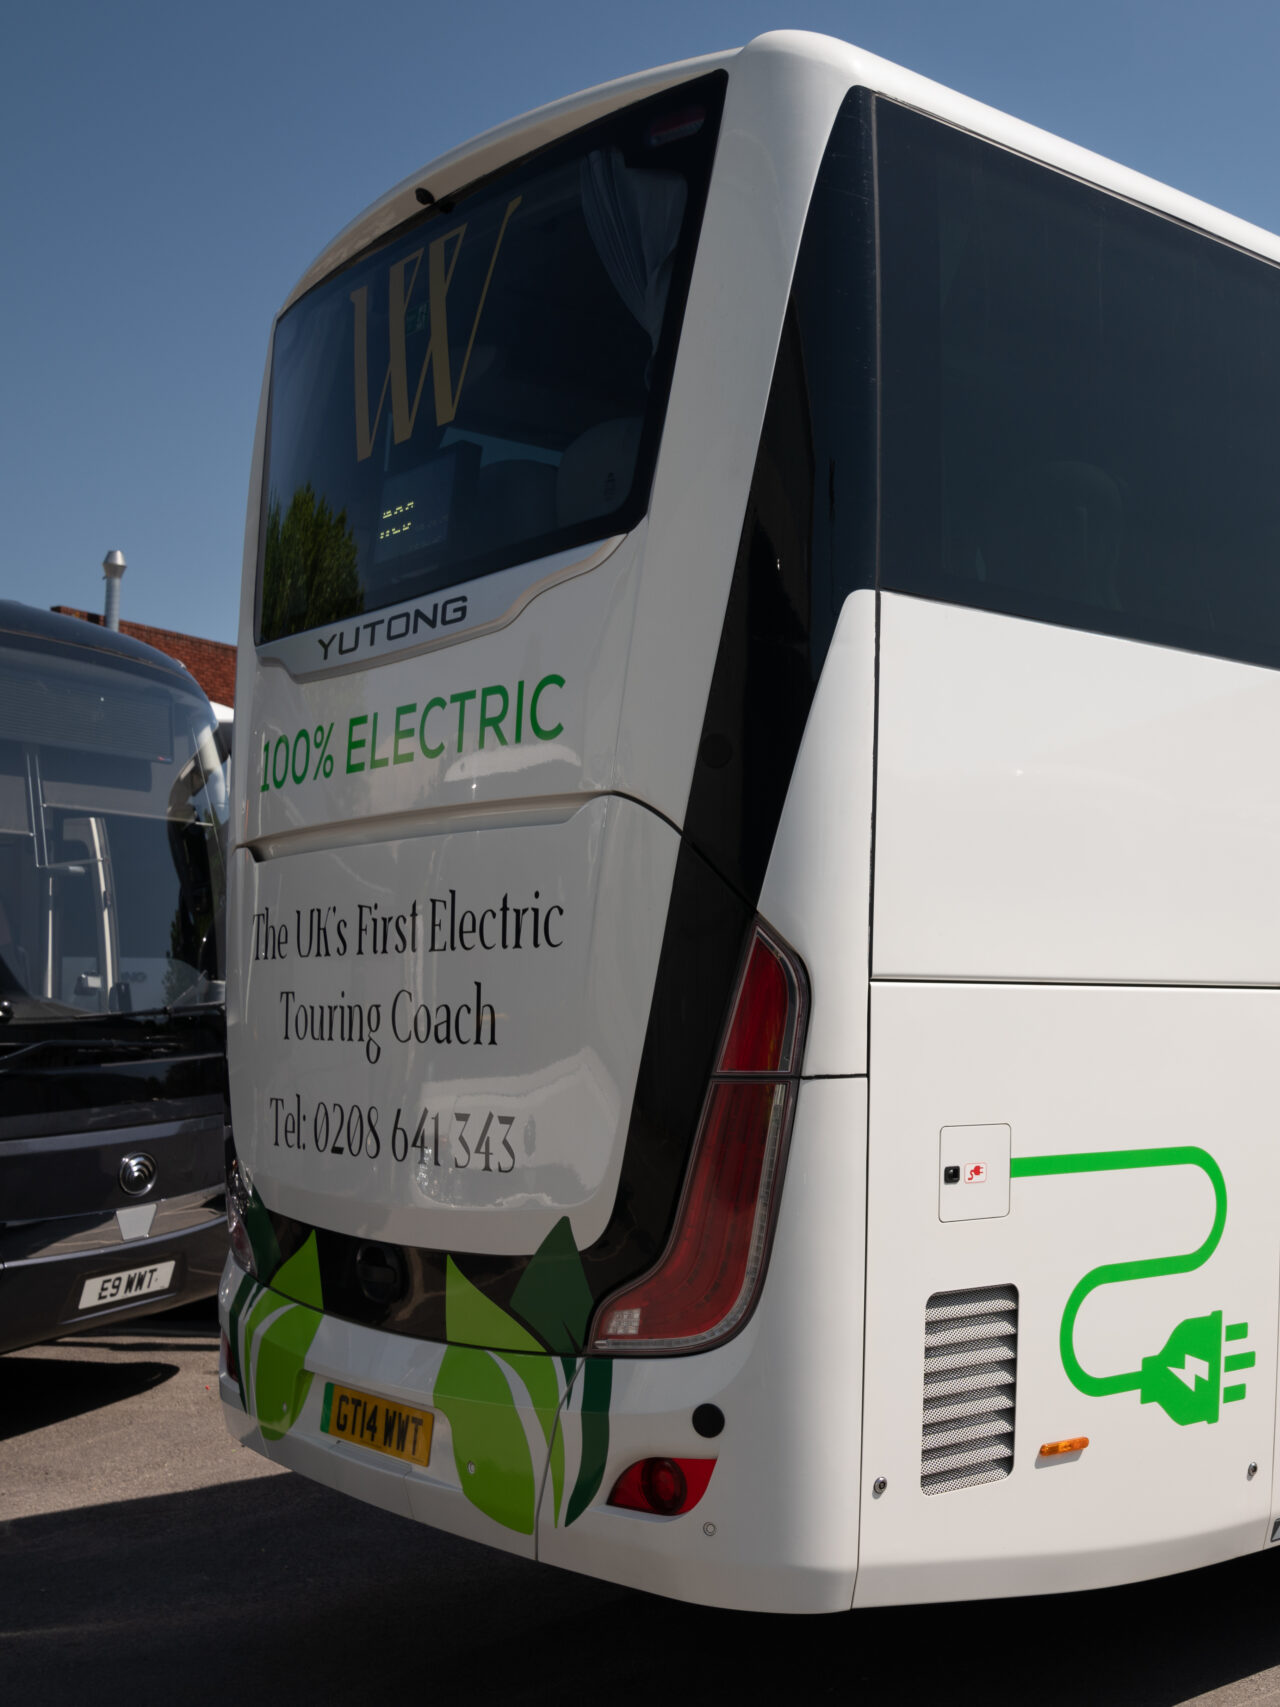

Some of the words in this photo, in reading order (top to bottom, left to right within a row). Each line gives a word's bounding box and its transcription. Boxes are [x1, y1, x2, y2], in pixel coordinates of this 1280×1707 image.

[317, 595, 469, 660] YUTONG
[260, 722, 335, 793] 100%
[345, 673, 566, 775] ELECTRIC
[253, 906, 288, 961] The
[296, 905, 348, 958] UK's
[356, 899, 418, 956] First
[428, 889, 564, 953] Electric
[280, 990, 382, 1065] Touring
[391, 981, 498, 1046] Coach
[270, 1093, 307, 1150] Tel:
[314, 1102, 381, 1159] 0208
[391, 1106, 441, 1167] 641
[454, 1111, 516, 1173] 343
[98, 1276, 122, 1301] E9
[124, 1268, 158, 1295] WWT
[336, 1394, 378, 1442] GT14
[383, 1408, 424, 1457] WWT
